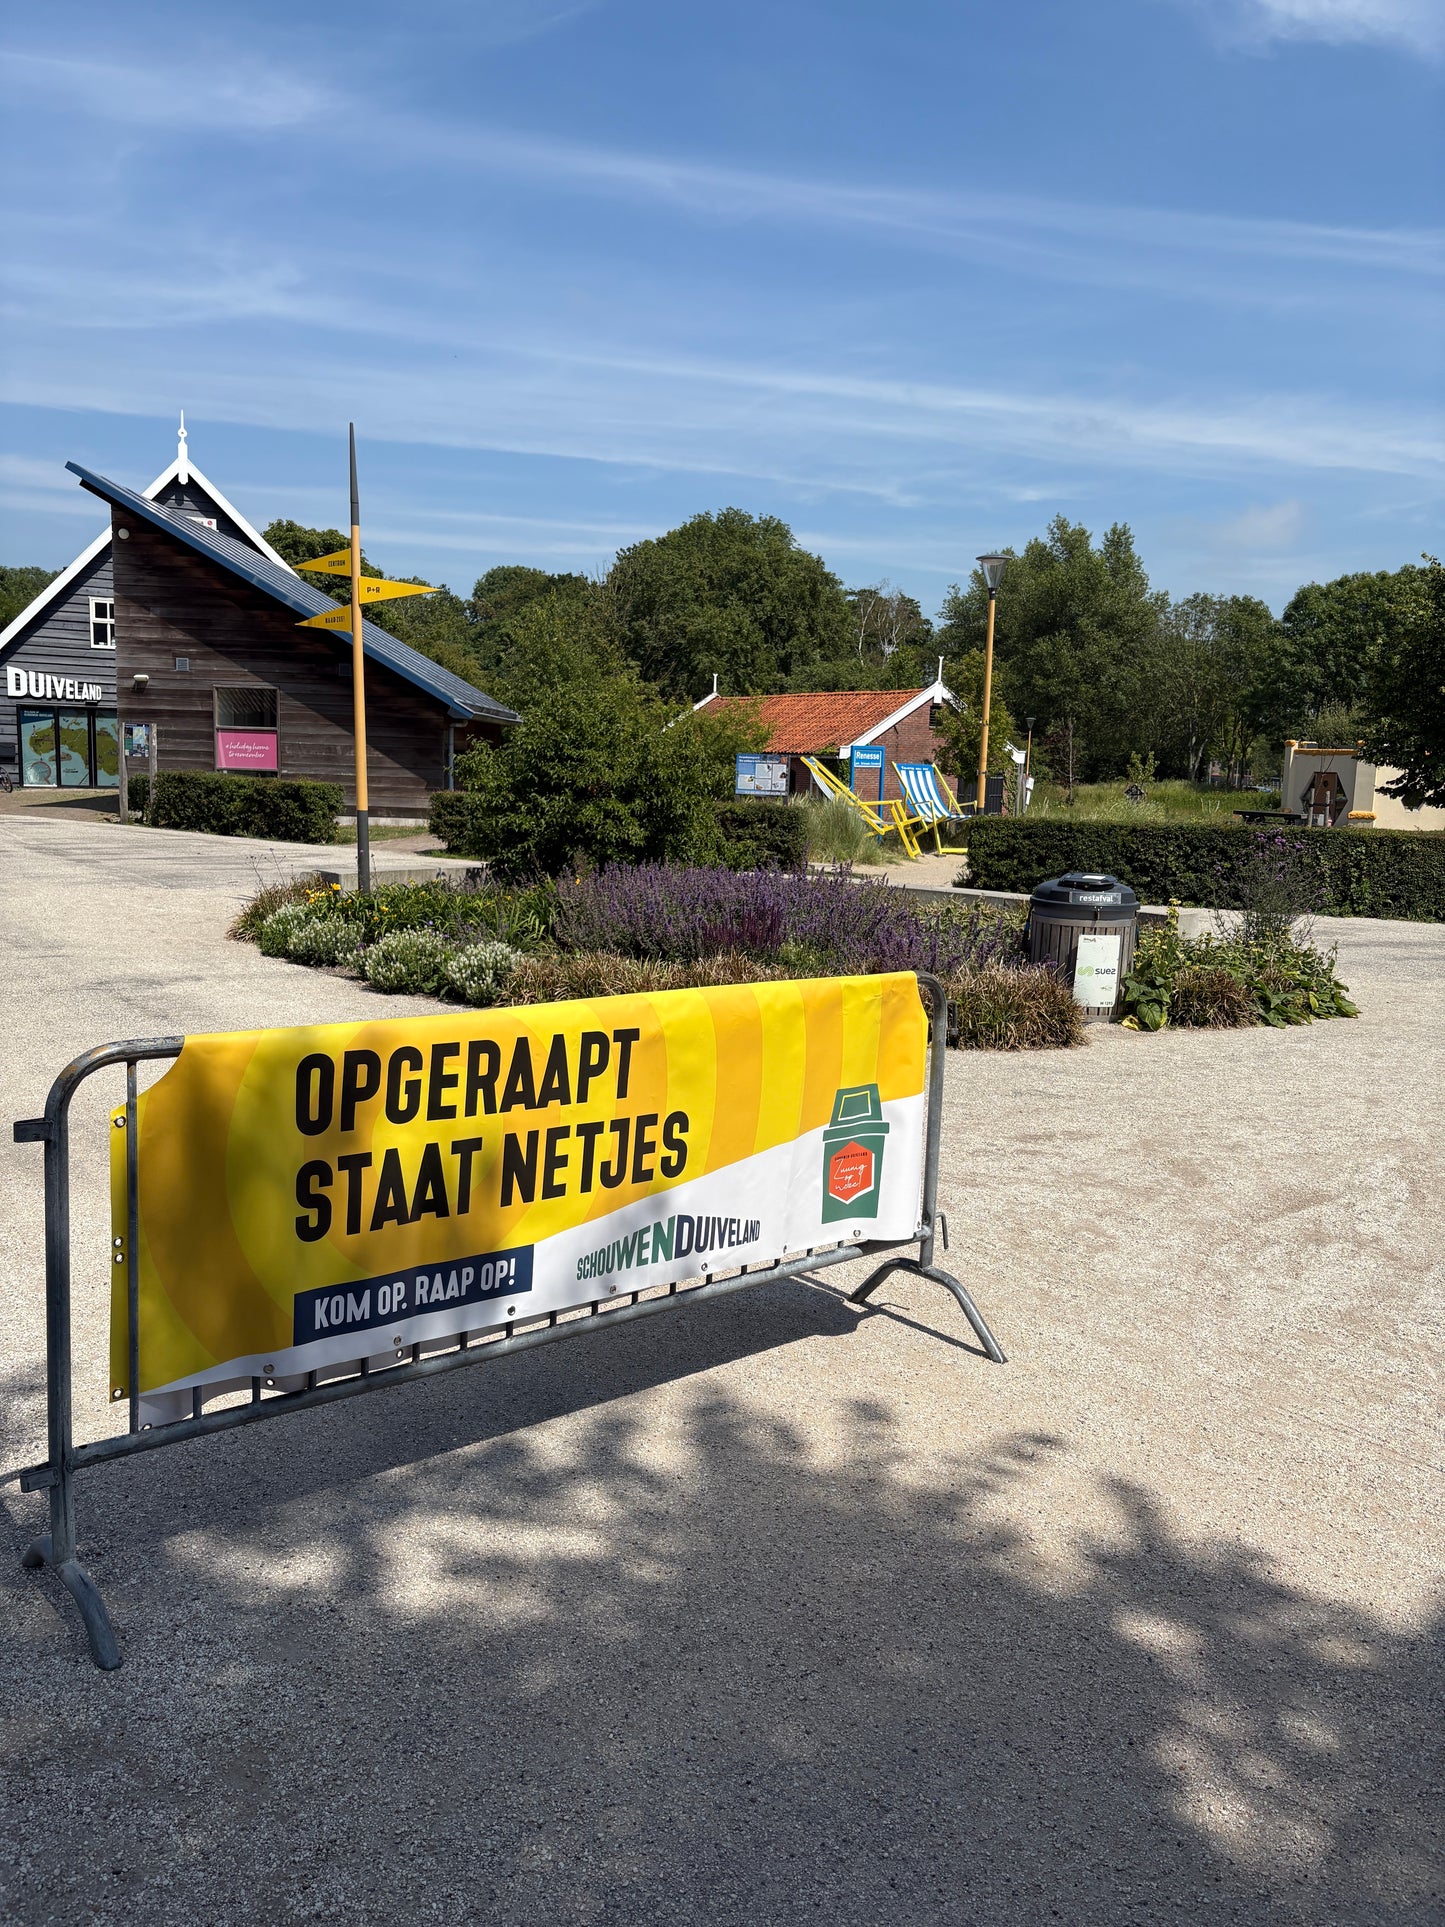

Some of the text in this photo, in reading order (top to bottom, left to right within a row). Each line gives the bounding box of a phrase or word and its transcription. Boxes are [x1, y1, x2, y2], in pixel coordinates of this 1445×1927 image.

[6, 665, 102, 701] DUIVELAND
[856, 751, 880, 760] Renesse
[1079, 895, 1114, 903] restafval
[1094, 967, 1116, 975] suez
[295, 1027, 640, 1137] OPGERAAPT
[295, 1110, 690, 1243] STAAT NETJES
[314, 1257, 517, 1330] KOM OP. RAAP OP!
